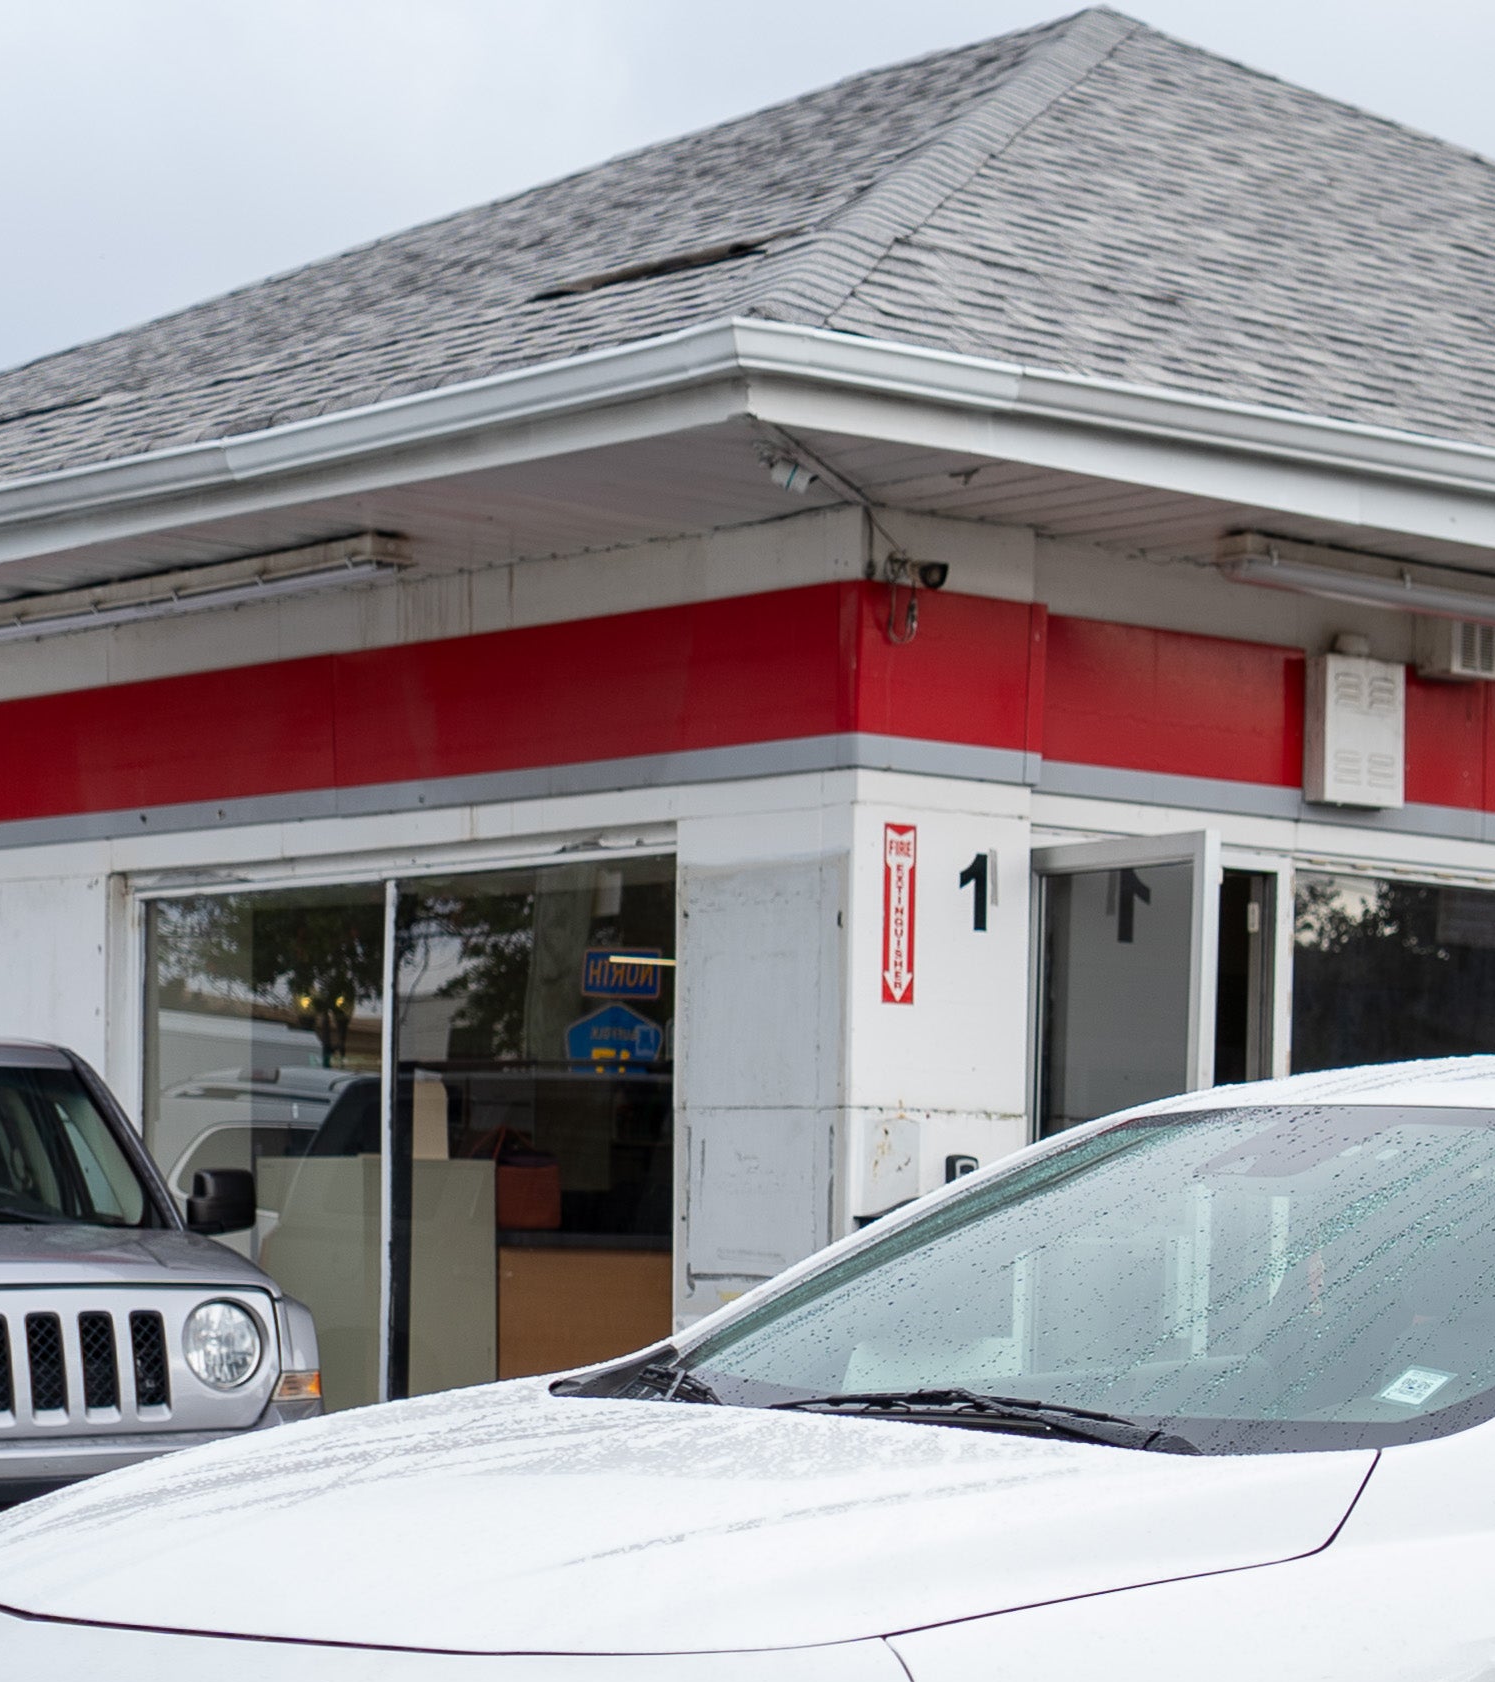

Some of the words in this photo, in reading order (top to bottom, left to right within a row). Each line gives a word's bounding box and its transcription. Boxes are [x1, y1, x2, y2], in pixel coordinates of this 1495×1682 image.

[889, 839, 911, 857] FIRE
[893, 863, 905, 989] EXTINGUISHER
[959, 853, 988, 931] 1
